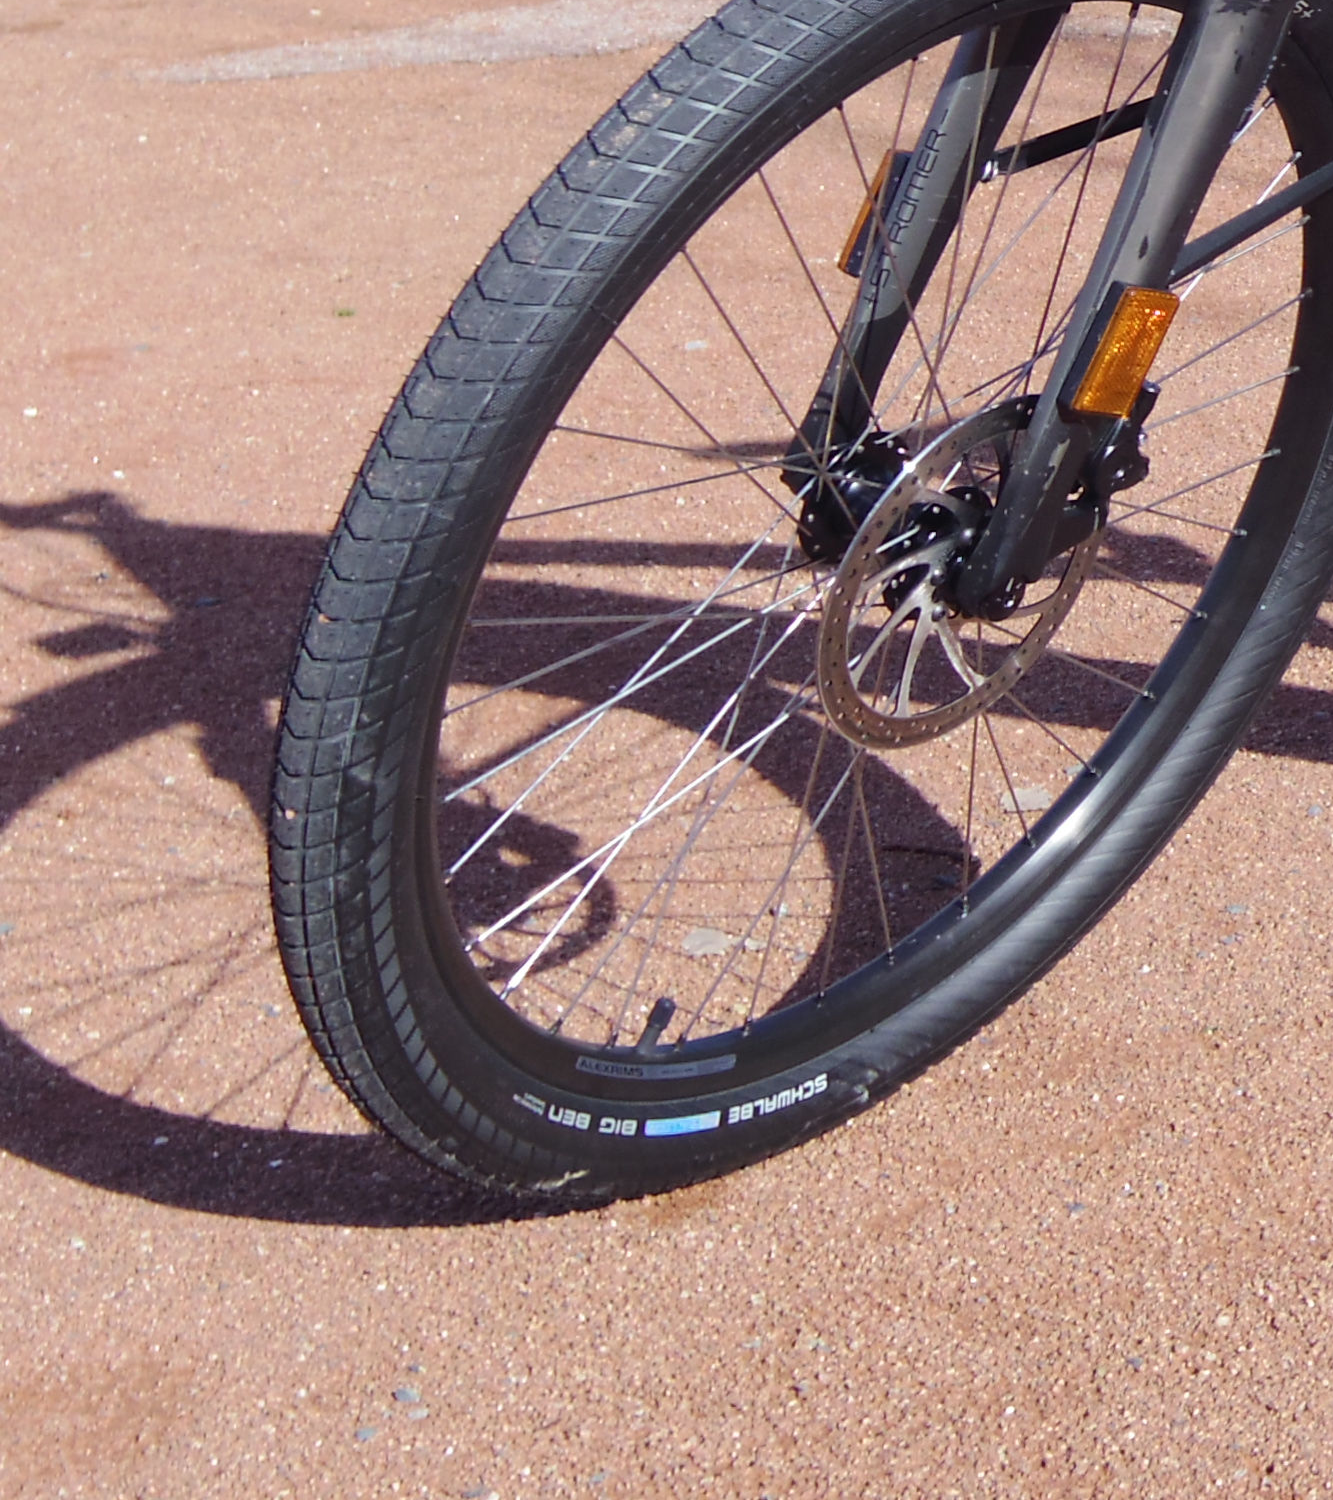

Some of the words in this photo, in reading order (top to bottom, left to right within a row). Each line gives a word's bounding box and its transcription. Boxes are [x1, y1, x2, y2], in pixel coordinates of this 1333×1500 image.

[580, 1056, 644, 1078] ALEXRIMS
[727, 1072, 828, 1125] SCHWALBE
[548, 1104, 591, 1130] BEN
[599, 1117, 638, 1136] BIG
